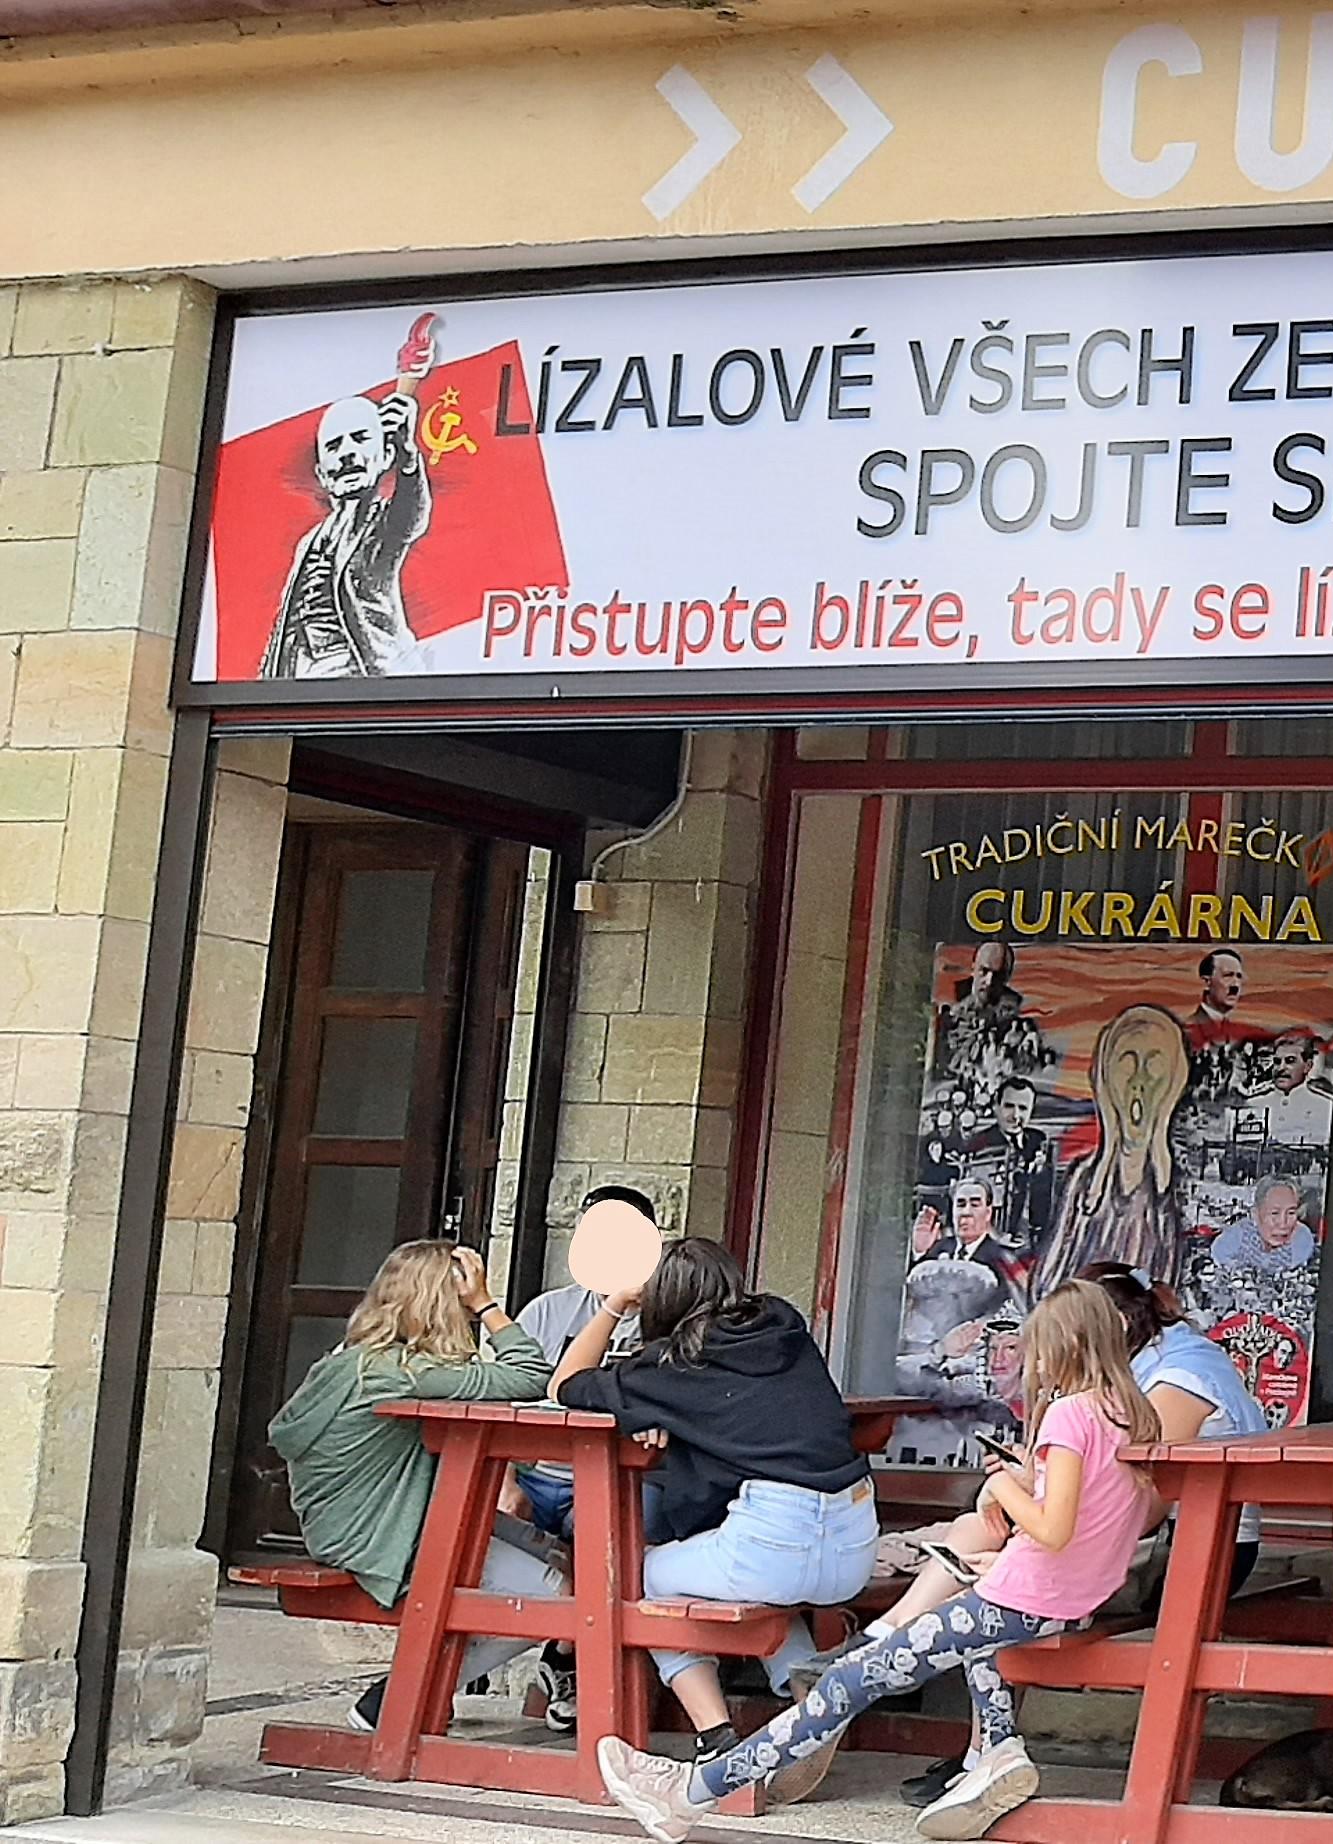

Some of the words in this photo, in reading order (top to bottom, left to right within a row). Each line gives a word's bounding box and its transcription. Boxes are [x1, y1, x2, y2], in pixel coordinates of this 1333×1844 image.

[494, 328, 878, 438] LÍZALOVÉ
[908, 320, 1195, 418] VŠECH
[856, 437, 1232, 539] SPOJTE
[483, 584, 787, 665] Přistupte
[809, 579, 979, 660] blíže,
[1007, 572, 1171, 654] tady
[1192, 582, 1270, 641] se
[920, 808, 1121, 881] TRADIČNÍ
[966, 880, 1321, 941] CUKRÁRNA
